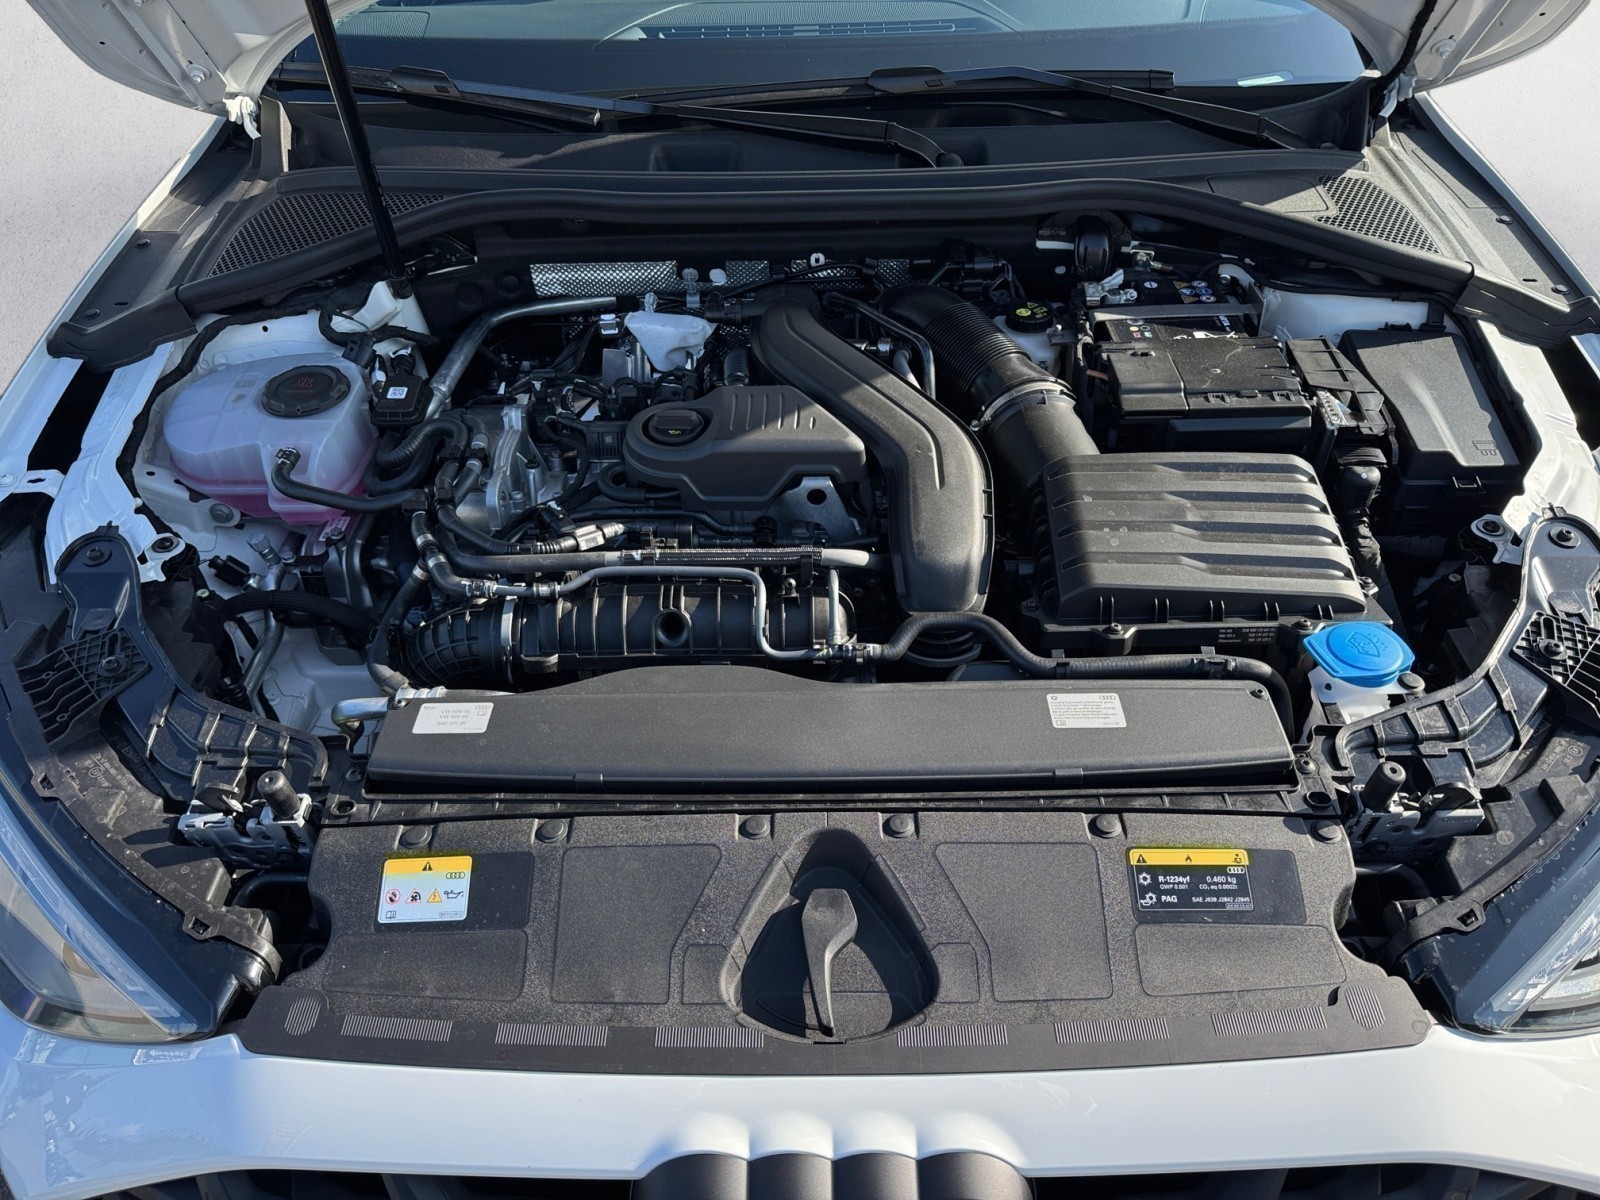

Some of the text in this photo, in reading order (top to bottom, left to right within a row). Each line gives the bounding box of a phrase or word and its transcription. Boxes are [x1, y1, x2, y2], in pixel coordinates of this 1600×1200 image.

[1158, 875, 1190, 884] R-1234yf
[1227, 875, 1237, 884] kg
[1161, 895, 1178, 903] PAG
